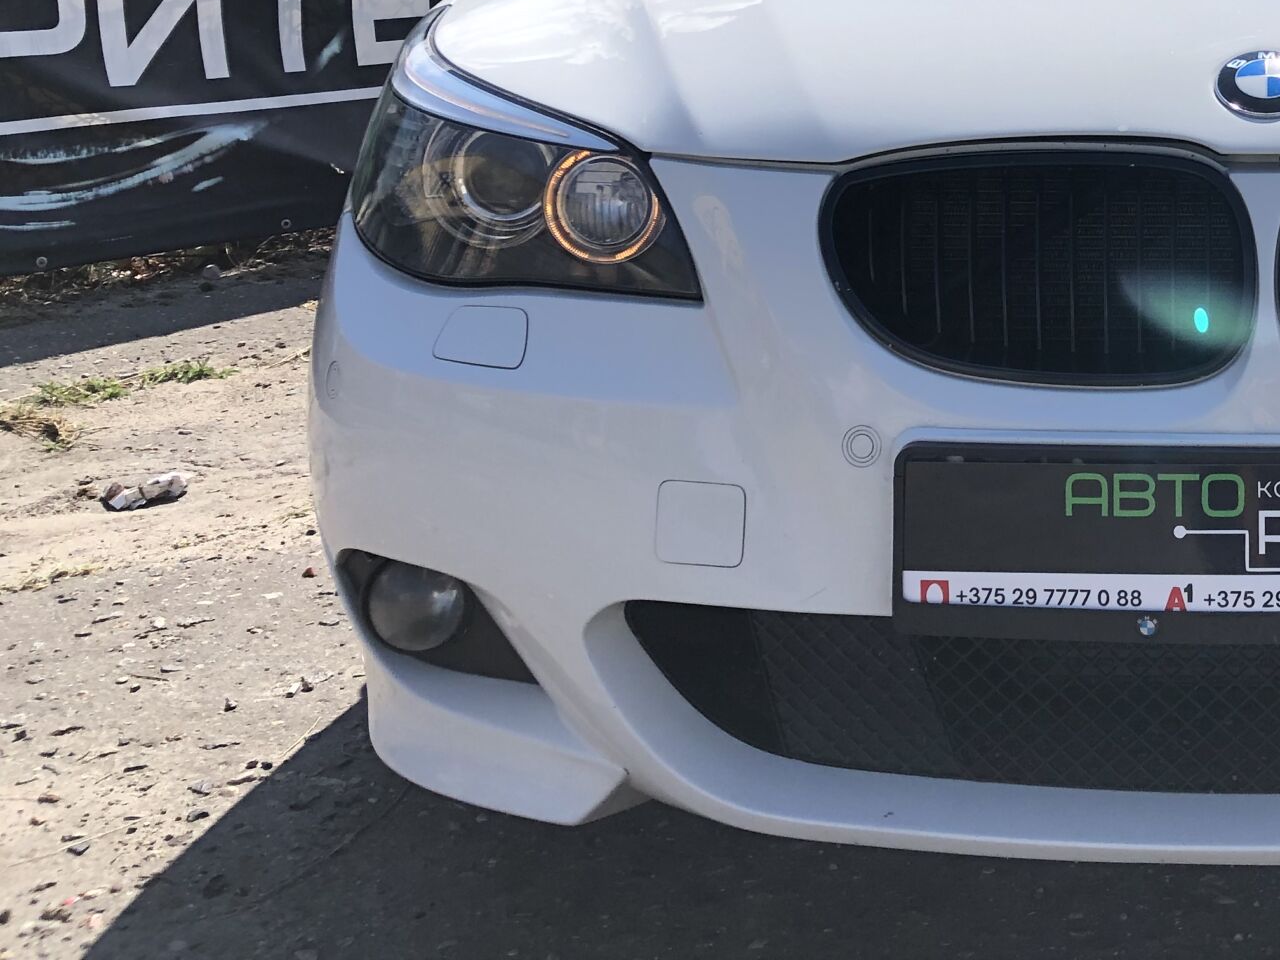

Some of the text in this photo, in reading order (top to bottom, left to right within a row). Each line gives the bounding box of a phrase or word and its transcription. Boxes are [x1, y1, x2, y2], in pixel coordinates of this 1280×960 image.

[1065, 472, 1246, 518] АВТО
[956, 587, 1142, 607] +375 29 7777 0 88
[1164, 583, 1193, 612] A1
[1203, 591, 1255, 609] +375
